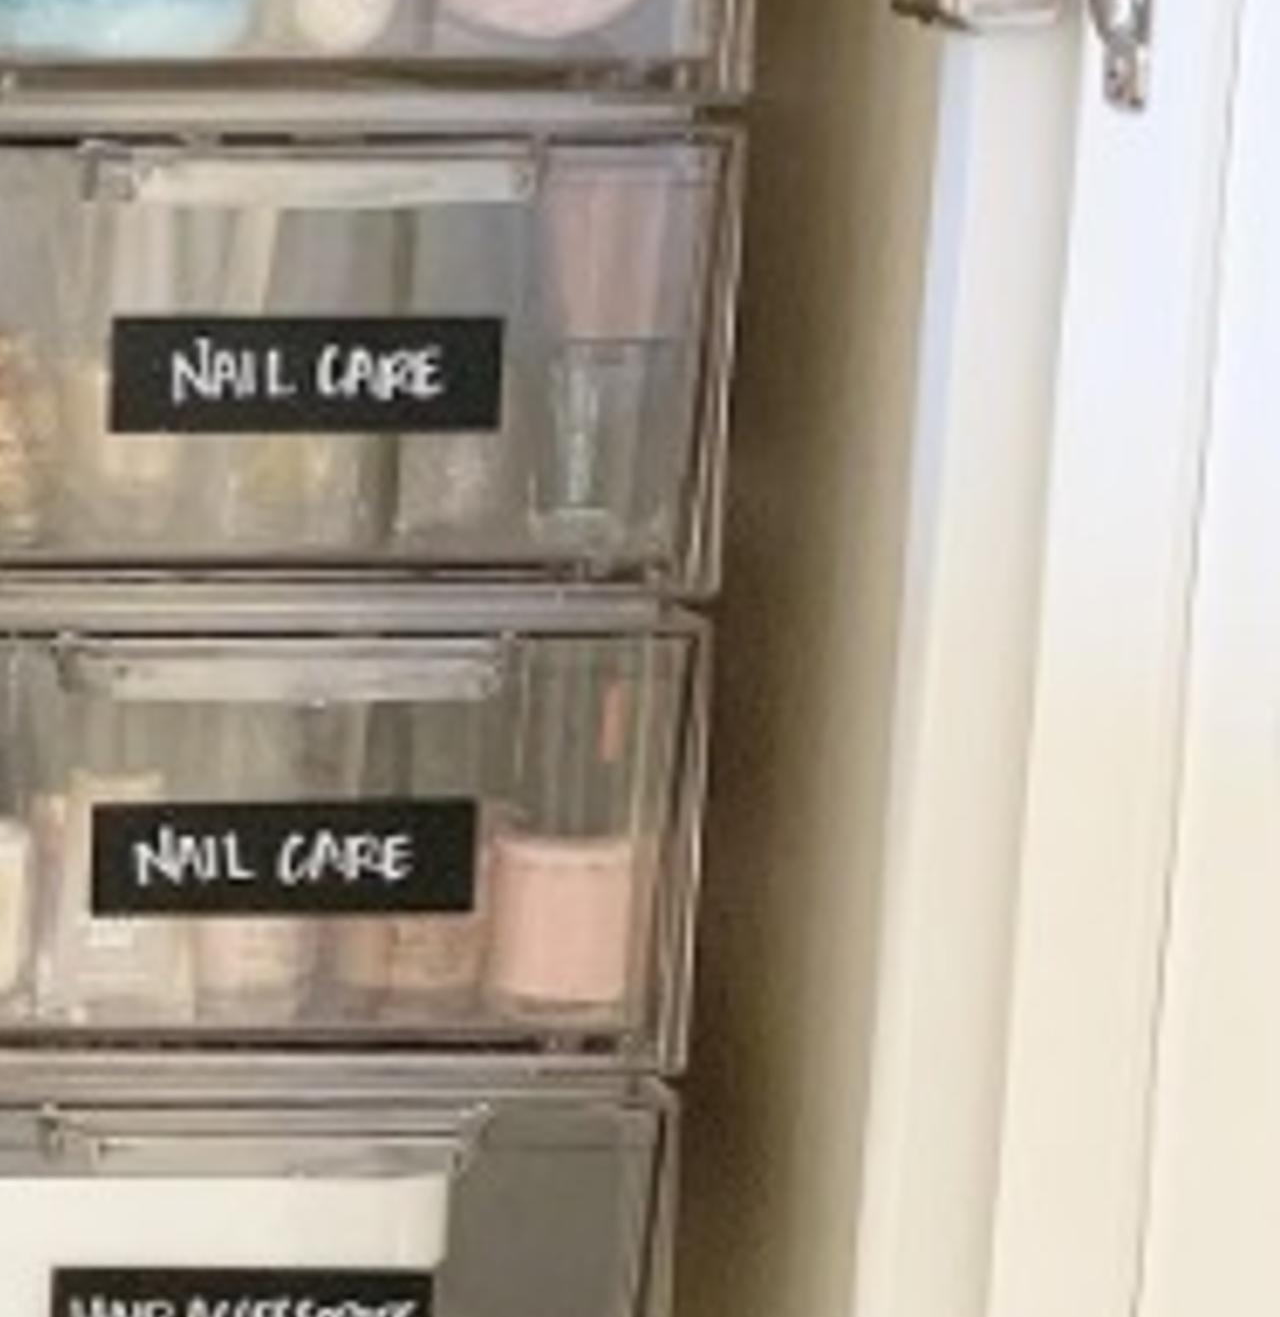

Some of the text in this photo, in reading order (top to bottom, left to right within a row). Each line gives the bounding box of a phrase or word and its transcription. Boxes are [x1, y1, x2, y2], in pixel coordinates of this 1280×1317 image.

[170, 338, 443, 403] NAIL CARE
[132, 825, 416, 885] NAIL CARE
